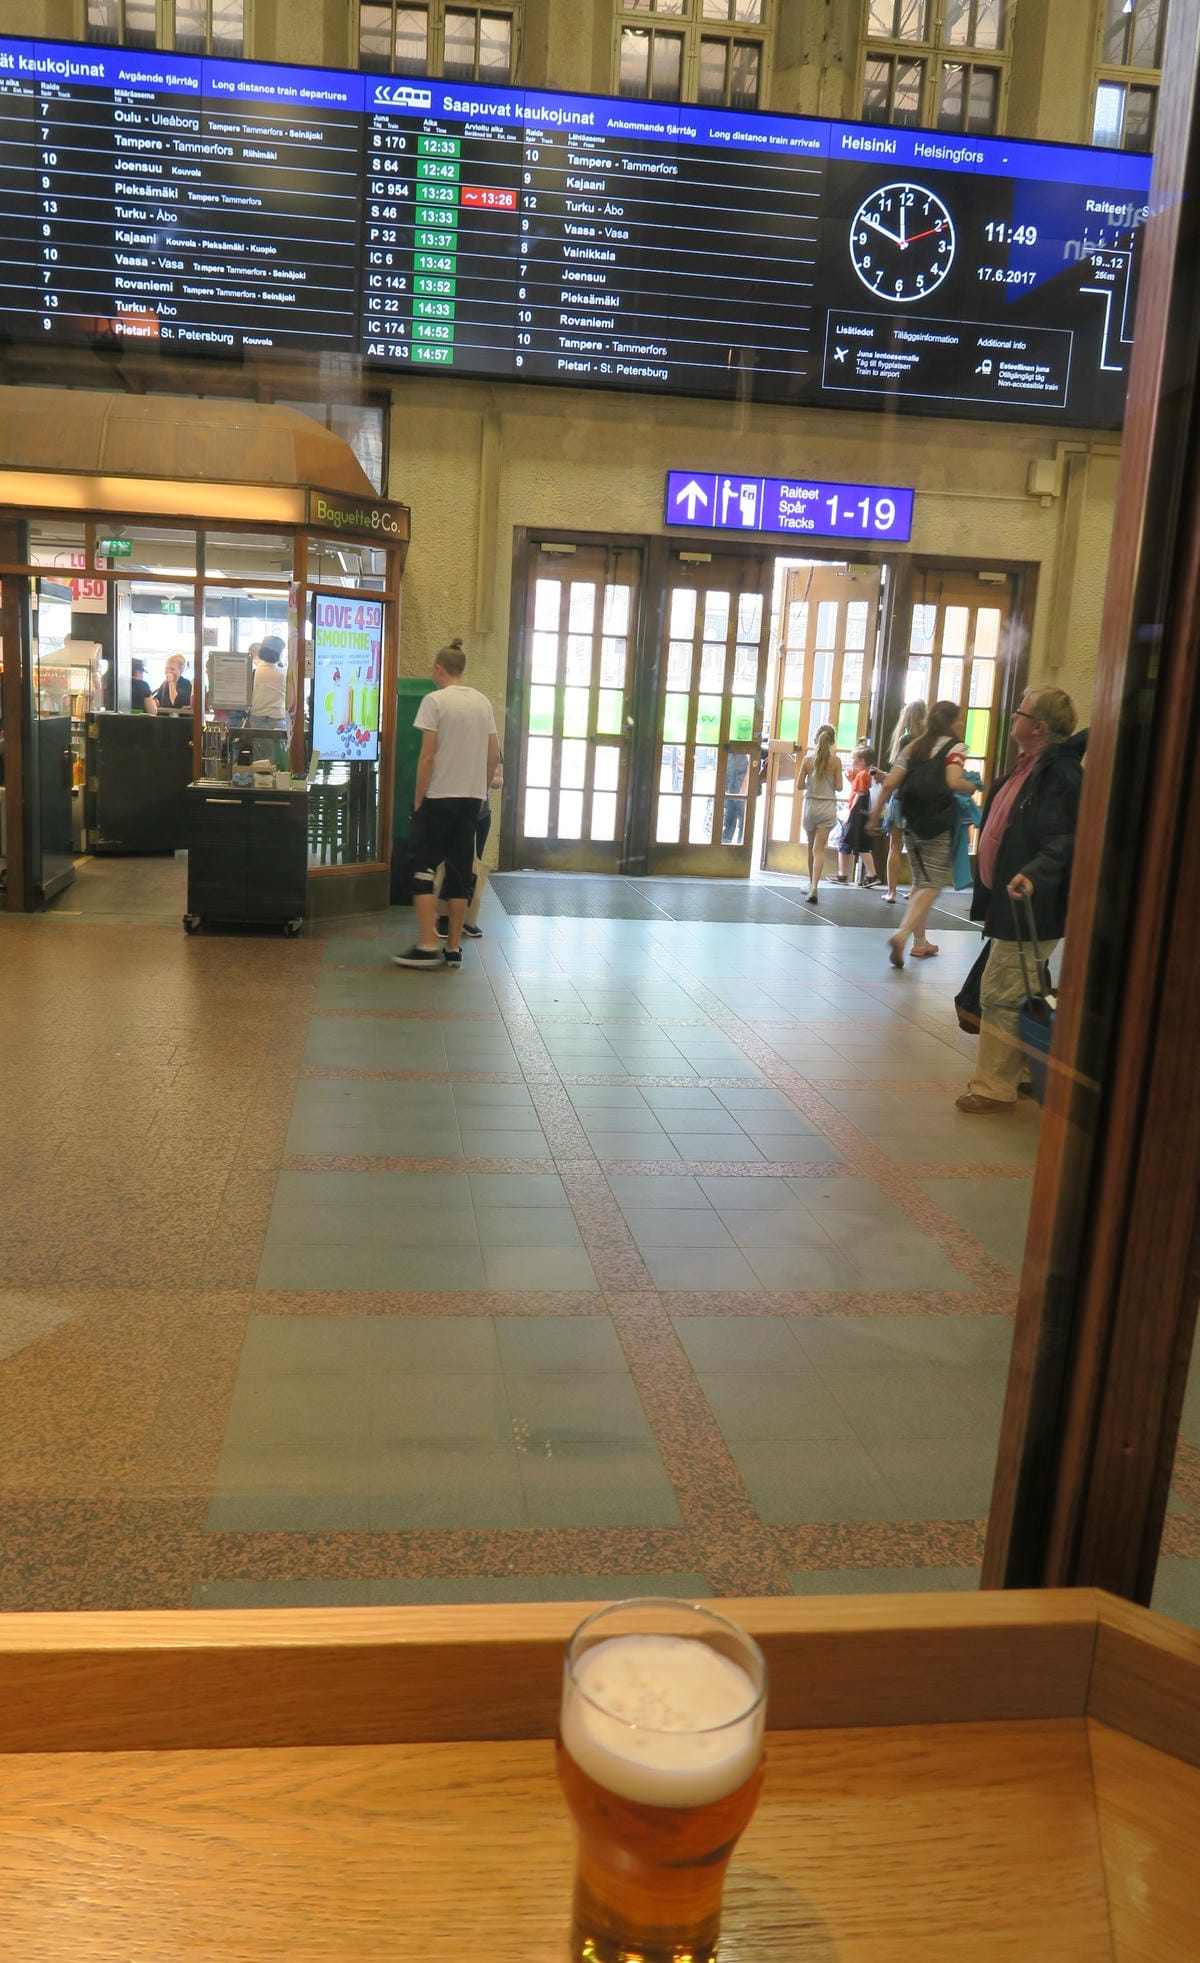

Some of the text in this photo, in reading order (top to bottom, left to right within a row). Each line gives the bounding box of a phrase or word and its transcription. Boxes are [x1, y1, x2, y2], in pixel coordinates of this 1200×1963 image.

[19, 55, 104, 77] kaukojunat
[119, 70, 198, 88] Avgående fjärrtåg
[212, 80, 346, 100] Long distance train departures
[444, 97, 594, 125] Saapuvat kaukojunat
[42, 104, 322, 140] 7 Oulu Uleåborg Tampere Tammerfors Seinäjoki
[607, 119, 696, 137] Ankommande fjärrtåg
[42, 128, 277, 160] 7 Tampere Tammerfors Riihimäki
[710, 129, 820, 148] Long distance train arrivals
[842, 135, 896, 153] Helsinki
[43, 152, 162, 173] 10 Joensuu
[374, 135, 678, 174] S 170 12:33 10 Tampere Tammerfors
[914, 143, 983, 163] Helsingfors
[373, 159, 604, 190] S 64 12:42 9 Kajaani
[42, 177, 178, 198] 9 Pieksämäki
[188, 192, 262, 206] Tampere Tammerfors
[372, 182, 623, 215] IC 954 13:23 13:26 12 Turku Åbo
[879, 199, 891, 211] 11
[900, 193, 914, 206] 12
[44, 201, 177, 222] 13 Turku Åbo
[372, 206, 452, 223] S 46 13:33
[923, 203, 928, 215] 1
[522, 220, 628, 239] 9 Vaasa Vasa
[934, 220, 942, 232] 2
[985, 222, 1036, 245] 11:49
[43, 225, 276, 254] 9 Kajaani Kouvola Pieksämäki Kuopio
[371, 229, 615, 260] P 32 13:37 8 Vainikkala
[860, 233, 866, 244] 9
[938, 241, 945, 252] 3
[44, 248, 306, 280] 10 Vaasa Vasa Tammerfors Seinäjoki
[370, 252, 606, 282] IC 6 13:42 7 Joensuu
[864, 256, 870, 268] 8
[930, 263, 938, 274] 4
[876, 271, 883, 283] 7
[896, 280, 902, 291] 6
[916, 275, 924, 287] 5
[978, 268, 1036, 284] 17.6.2017
[44, 272, 295, 302] 7 Rovaniemi Tampere Tammerfors Seinäjoki
[370, 275, 619, 306] IC 142 13:52 6 Pieksämäki
[44, 296, 176, 315] 13 Turku Åbo
[370, 298, 614, 328] IC 22 14:33 10 Rovaniemi
[44, 319, 272, 345] 9 Pietari St. Petersburg Kouvola
[369, 321, 667, 355] IC 174 14:52 10 Tampere Tammerfors
[836, 326, 873, 336] Lisätiedot
[894, 330, 958, 344] Tilläggsinformation
[977, 338, 1026, 350] Additional info
[368, 344, 668, 380] AE 783 14:57 9 Pietari St. Petersburg
[780, 486, 819, 500] Raiteet
[317, 499, 401, 534] Baguette&Co.
[779, 500, 806, 515] Spår
[826, 495, 895, 530] 1-19
[778, 515, 814, 529] Tracks
[71, 553, 103, 568] LOE
[318, 603, 352, 629] LOVE
[317, 628, 370, 650] SMOOTHIE
